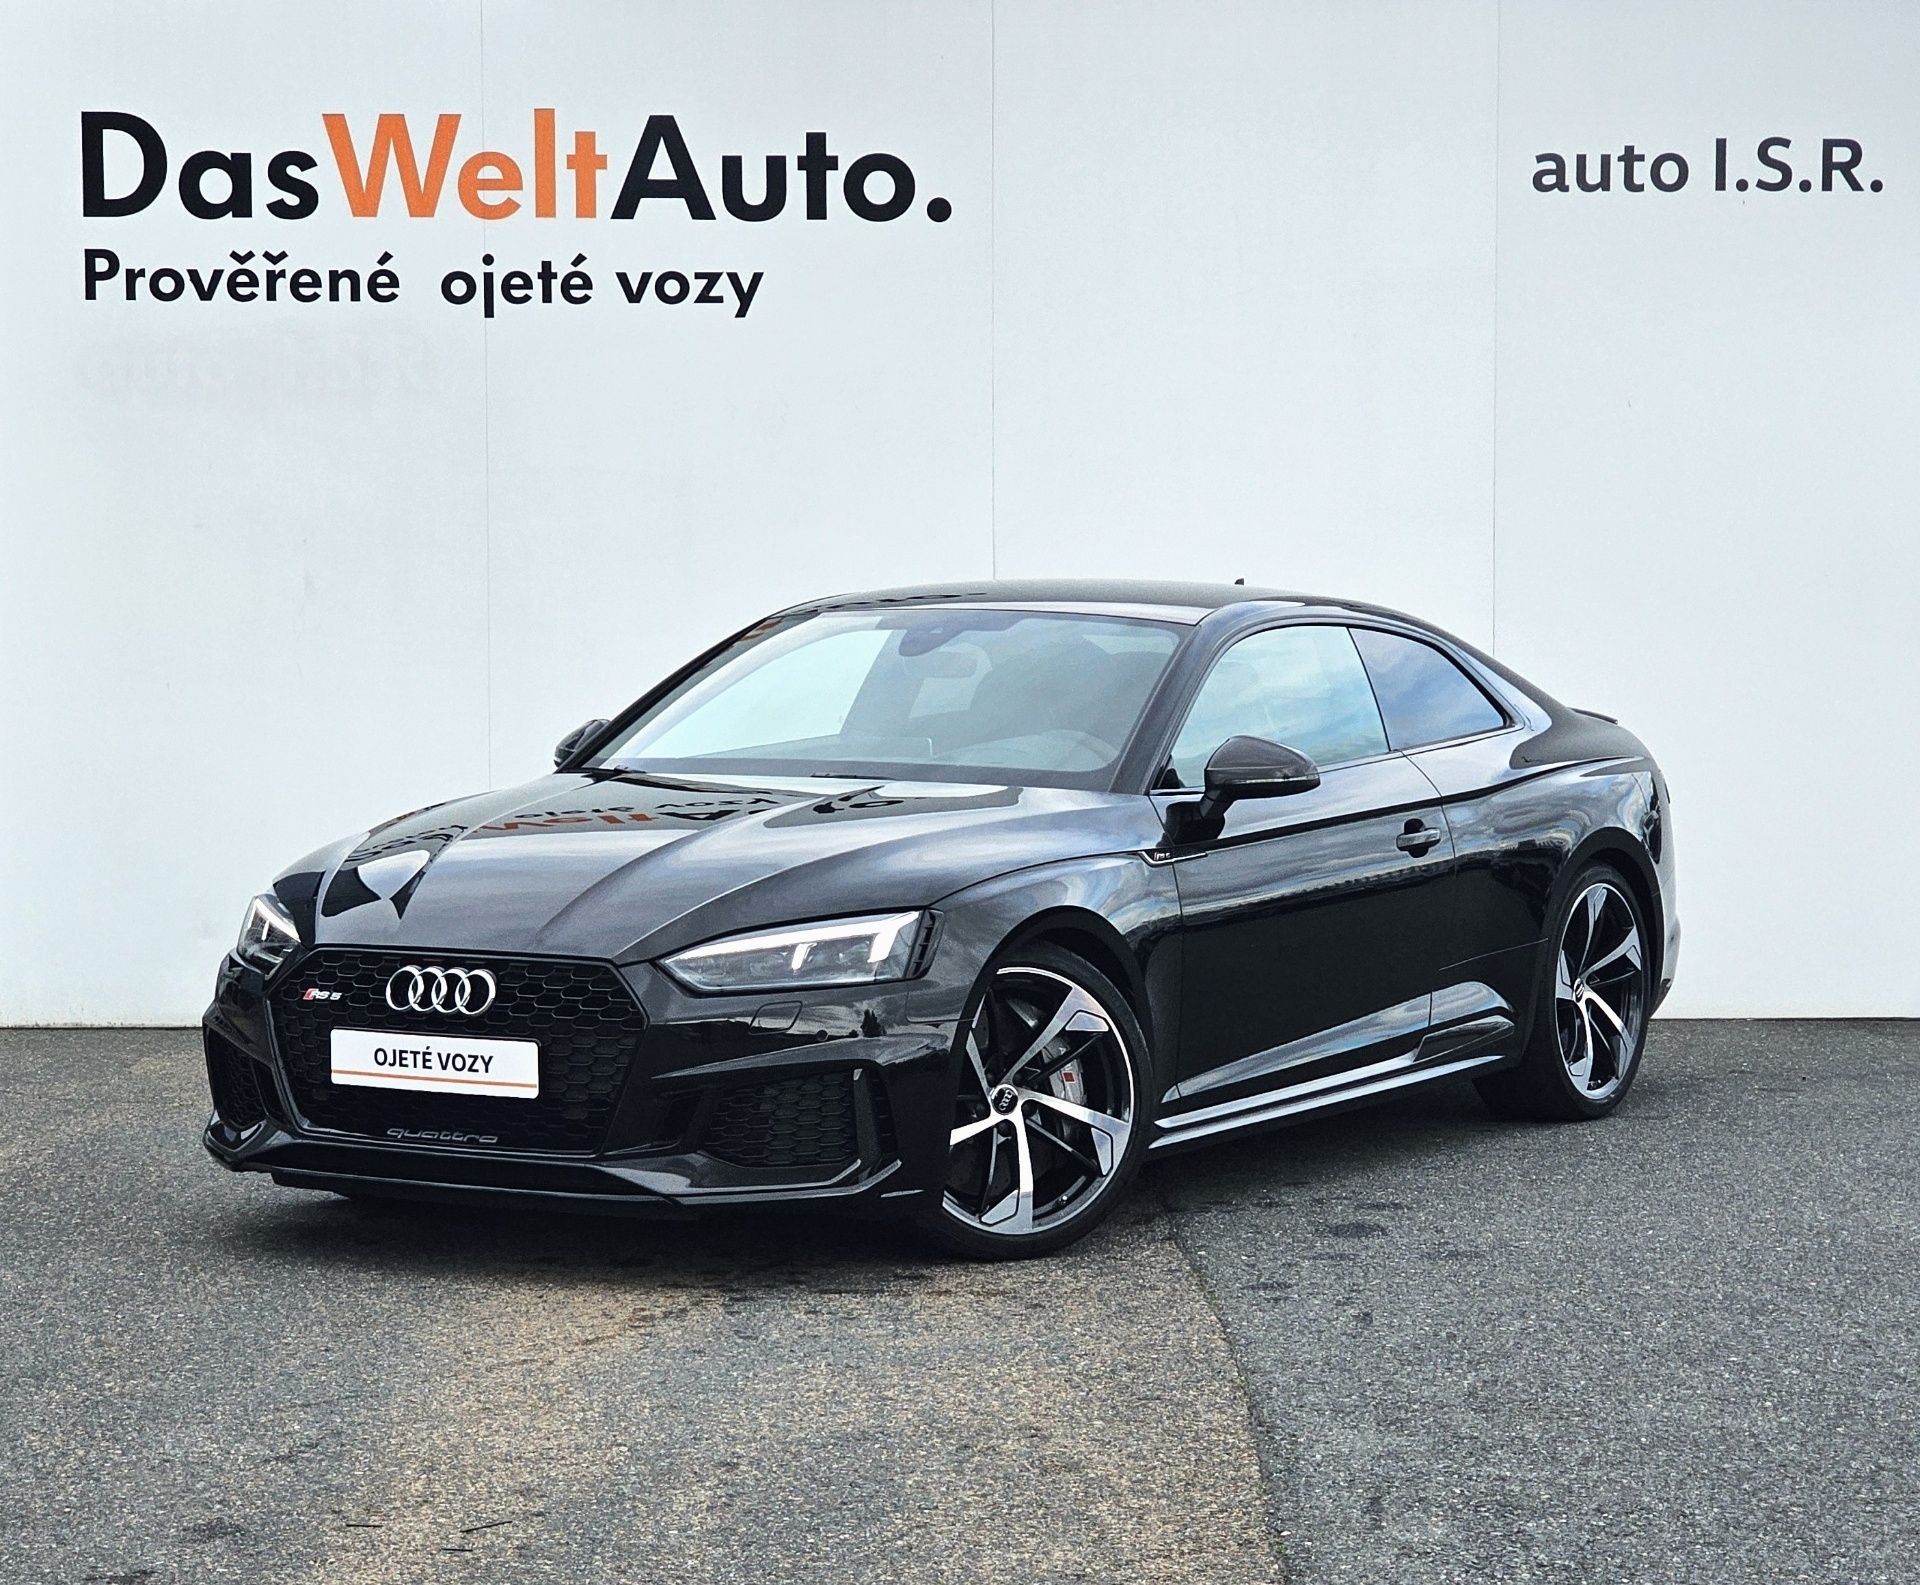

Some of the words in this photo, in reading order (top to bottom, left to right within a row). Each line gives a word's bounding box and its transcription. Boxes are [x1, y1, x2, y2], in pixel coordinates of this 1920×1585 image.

[1532, 144, 1688, 192] auto
[1714, 136, 1883, 192] I.S.R.
[82, 249, 399, 304] Prověřené
[440, 252, 593, 318] ojeté
[615, 268, 764, 318] vozy
[374, 1046, 433, 1070] OJETÉ
[437, 1052, 494, 1073] VOZY
[386, 1127, 498, 1143] quattro
